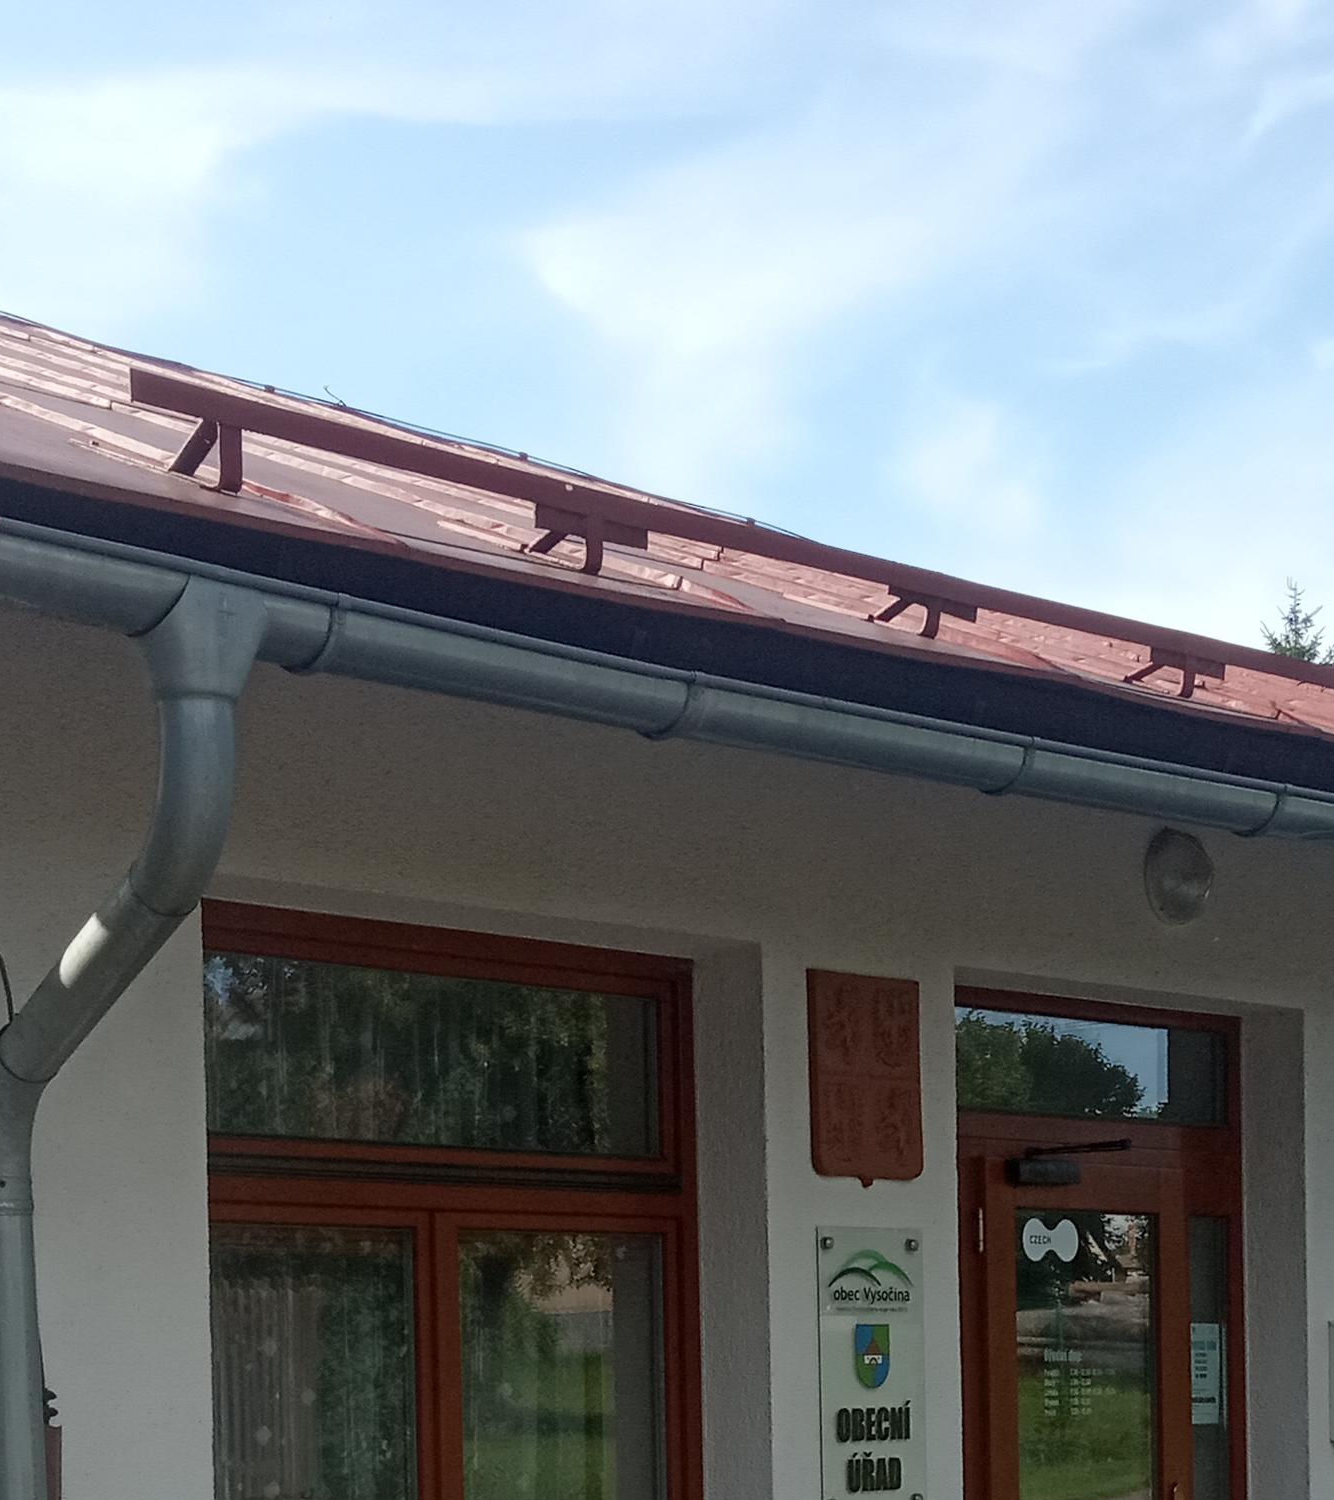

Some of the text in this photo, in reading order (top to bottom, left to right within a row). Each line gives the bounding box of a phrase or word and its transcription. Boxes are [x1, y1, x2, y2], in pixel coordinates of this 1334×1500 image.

[833, 1286, 910, 1304] obec Vysočina
[836, 1400, 911, 1442] OBECNÍ
[847, 1451, 901, 1492] ÚŘAD
